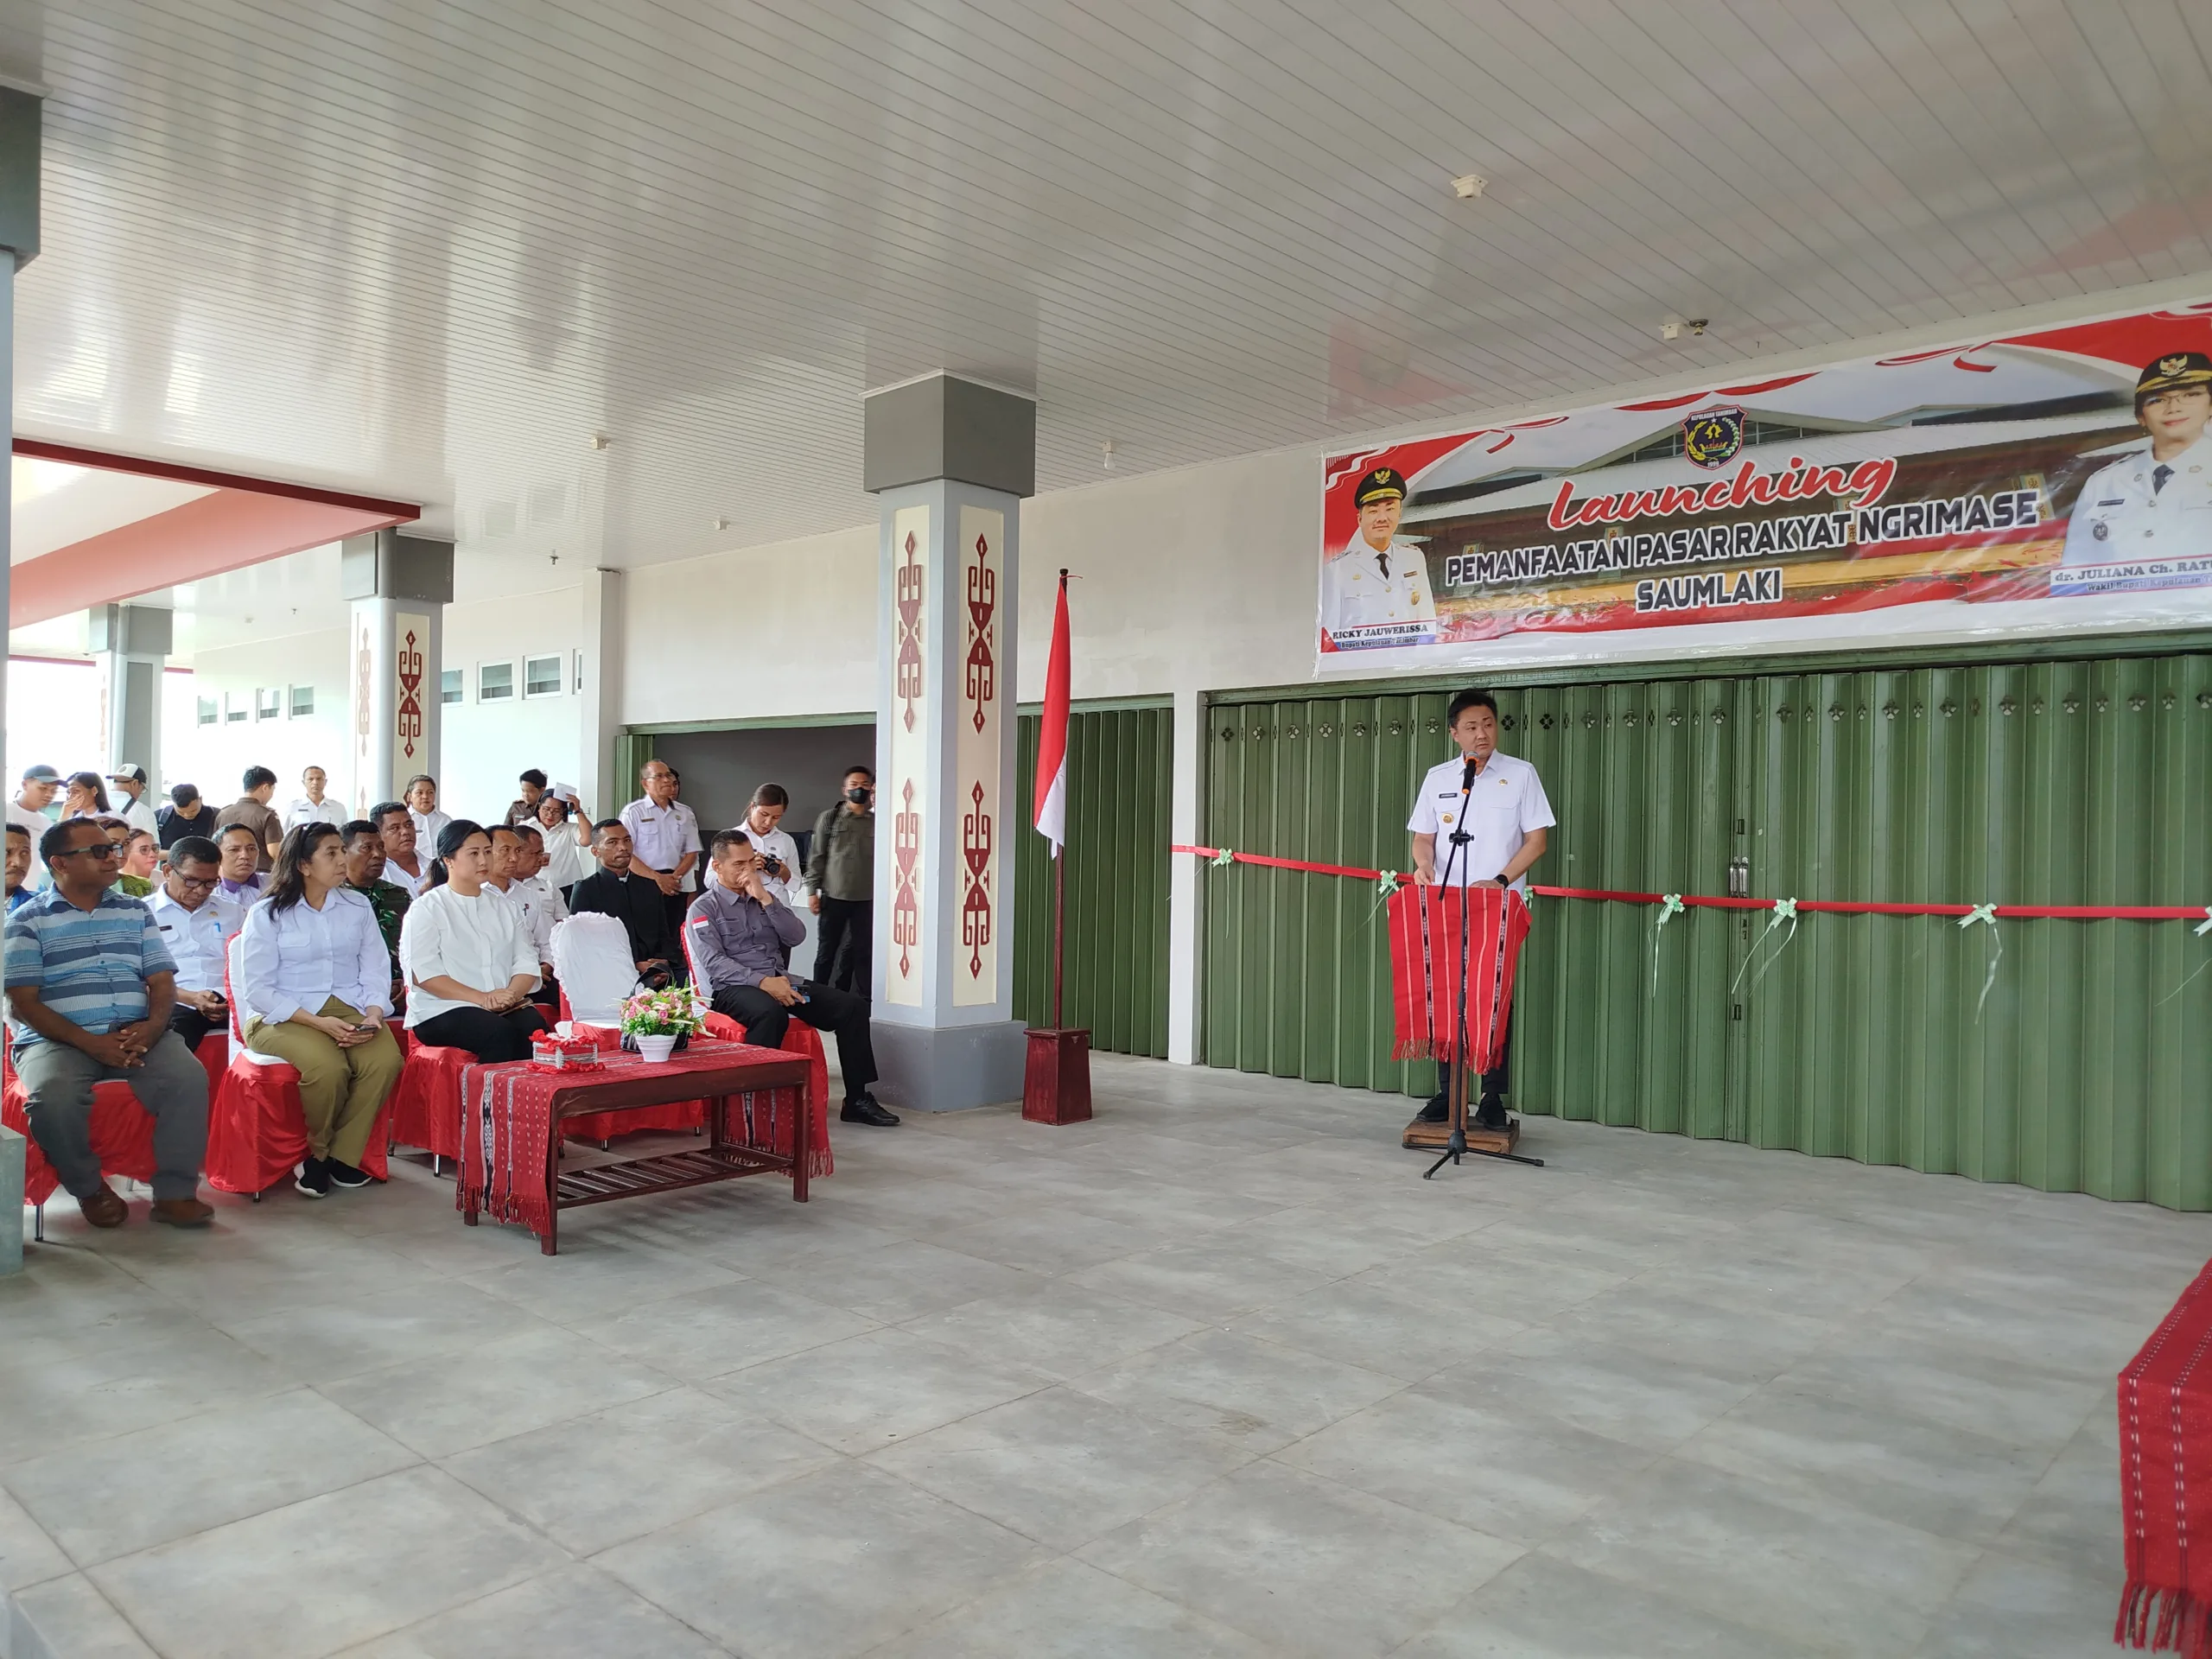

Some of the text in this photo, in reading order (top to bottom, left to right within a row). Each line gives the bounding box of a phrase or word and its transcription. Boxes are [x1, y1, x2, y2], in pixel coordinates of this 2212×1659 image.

[1549, 457, 1896, 530] Launching
[1446, 490, 2039, 586] PEMANFAATAN PASAR RAKYAT NGRIMASE
[2055, 572, 2075, 582] dr.
[2077, 565, 2145, 580] JULIANA
[2149, 563, 2173, 574] Ch.
[2087, 582, 2113, 591] Wakil
[1637, 569, 1782, 611] SAUMLAKI
[1332, 624, 1428, 639] RICKY JAUWERISSA
